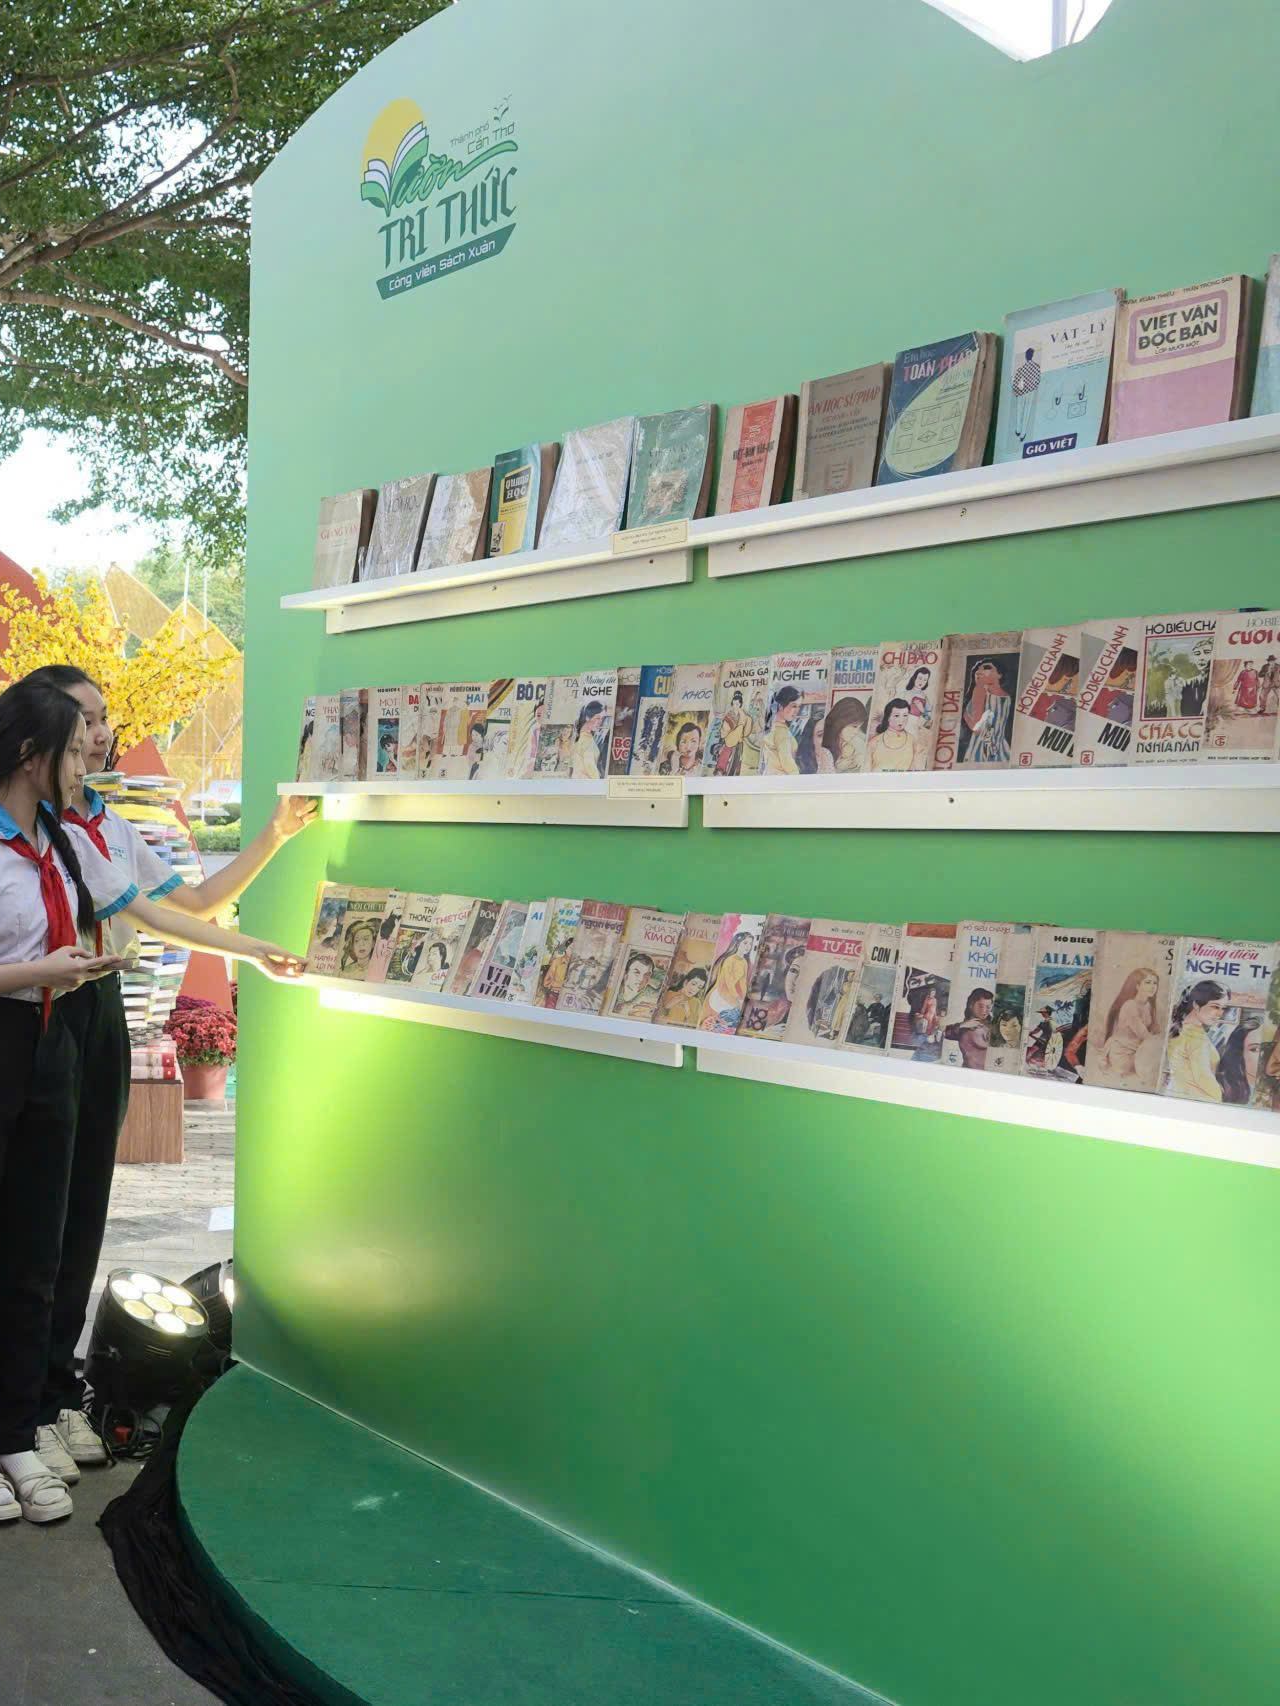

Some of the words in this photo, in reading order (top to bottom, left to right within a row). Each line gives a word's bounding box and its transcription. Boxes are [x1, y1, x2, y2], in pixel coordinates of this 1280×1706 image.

[436, 164, 518, 244] THỨC
[389, 272, 412, 291] Công
[439, 252, 465, 271] Sách
[468, 240, 495, 258] Xuân
[1138, 329, 1176, 350] ĐỌC
[773, 669, 810, 681] NGHE
[582, 686, 612, 696] NGHE
[531, 912, 544, 920] AI
[970, 935, 991, 947] HAI
[871, 946, 891, 963] CON
[1186, 960, 1241, 976] NGHE
